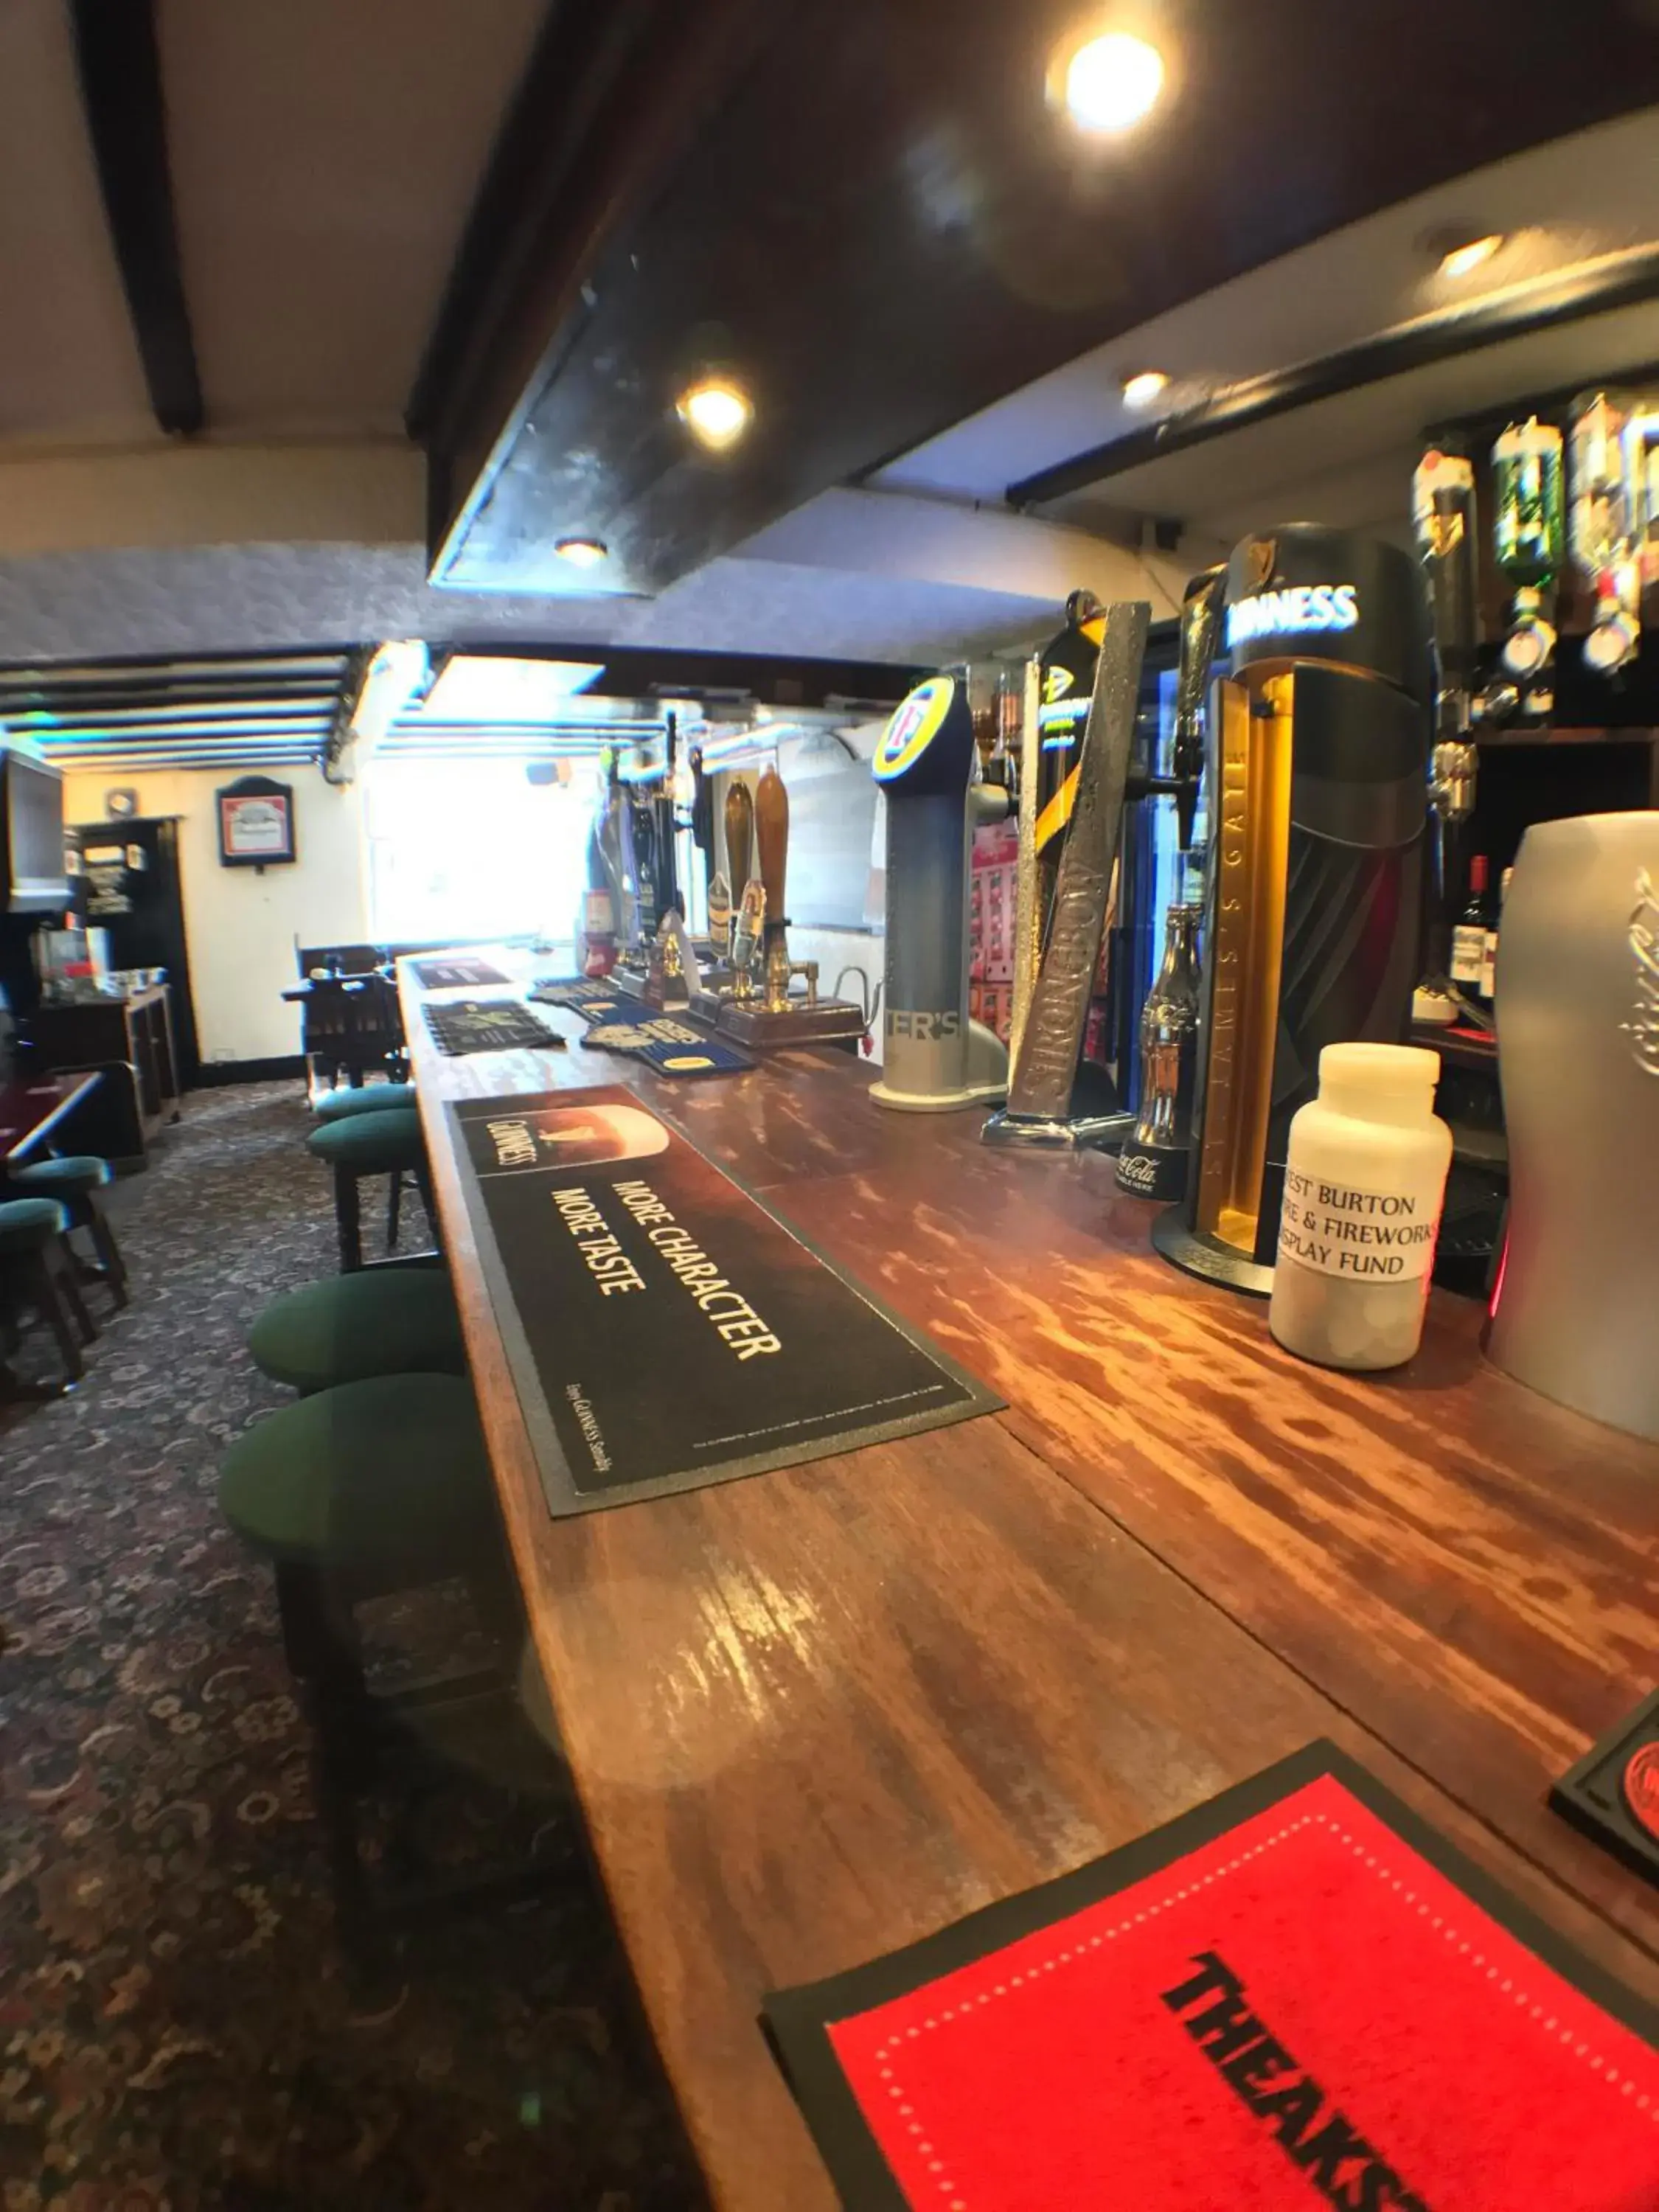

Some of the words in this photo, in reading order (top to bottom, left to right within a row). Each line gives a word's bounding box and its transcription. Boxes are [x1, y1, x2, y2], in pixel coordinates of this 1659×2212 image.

[1222, 751, 1248, 869] GATE
[552, 1188, 608, 1235] MORE
[1303, 1211, 1317, 1231] &
[1318, 1183, 1416, 1217] BURTON
[578, 1234, 646, 1296] TASTE
[611, 1180, 675, 1225] MORE
[648, 1226, 782, 1360] CHARACTER
[1339, 1251, 1405, 1275] FUND
